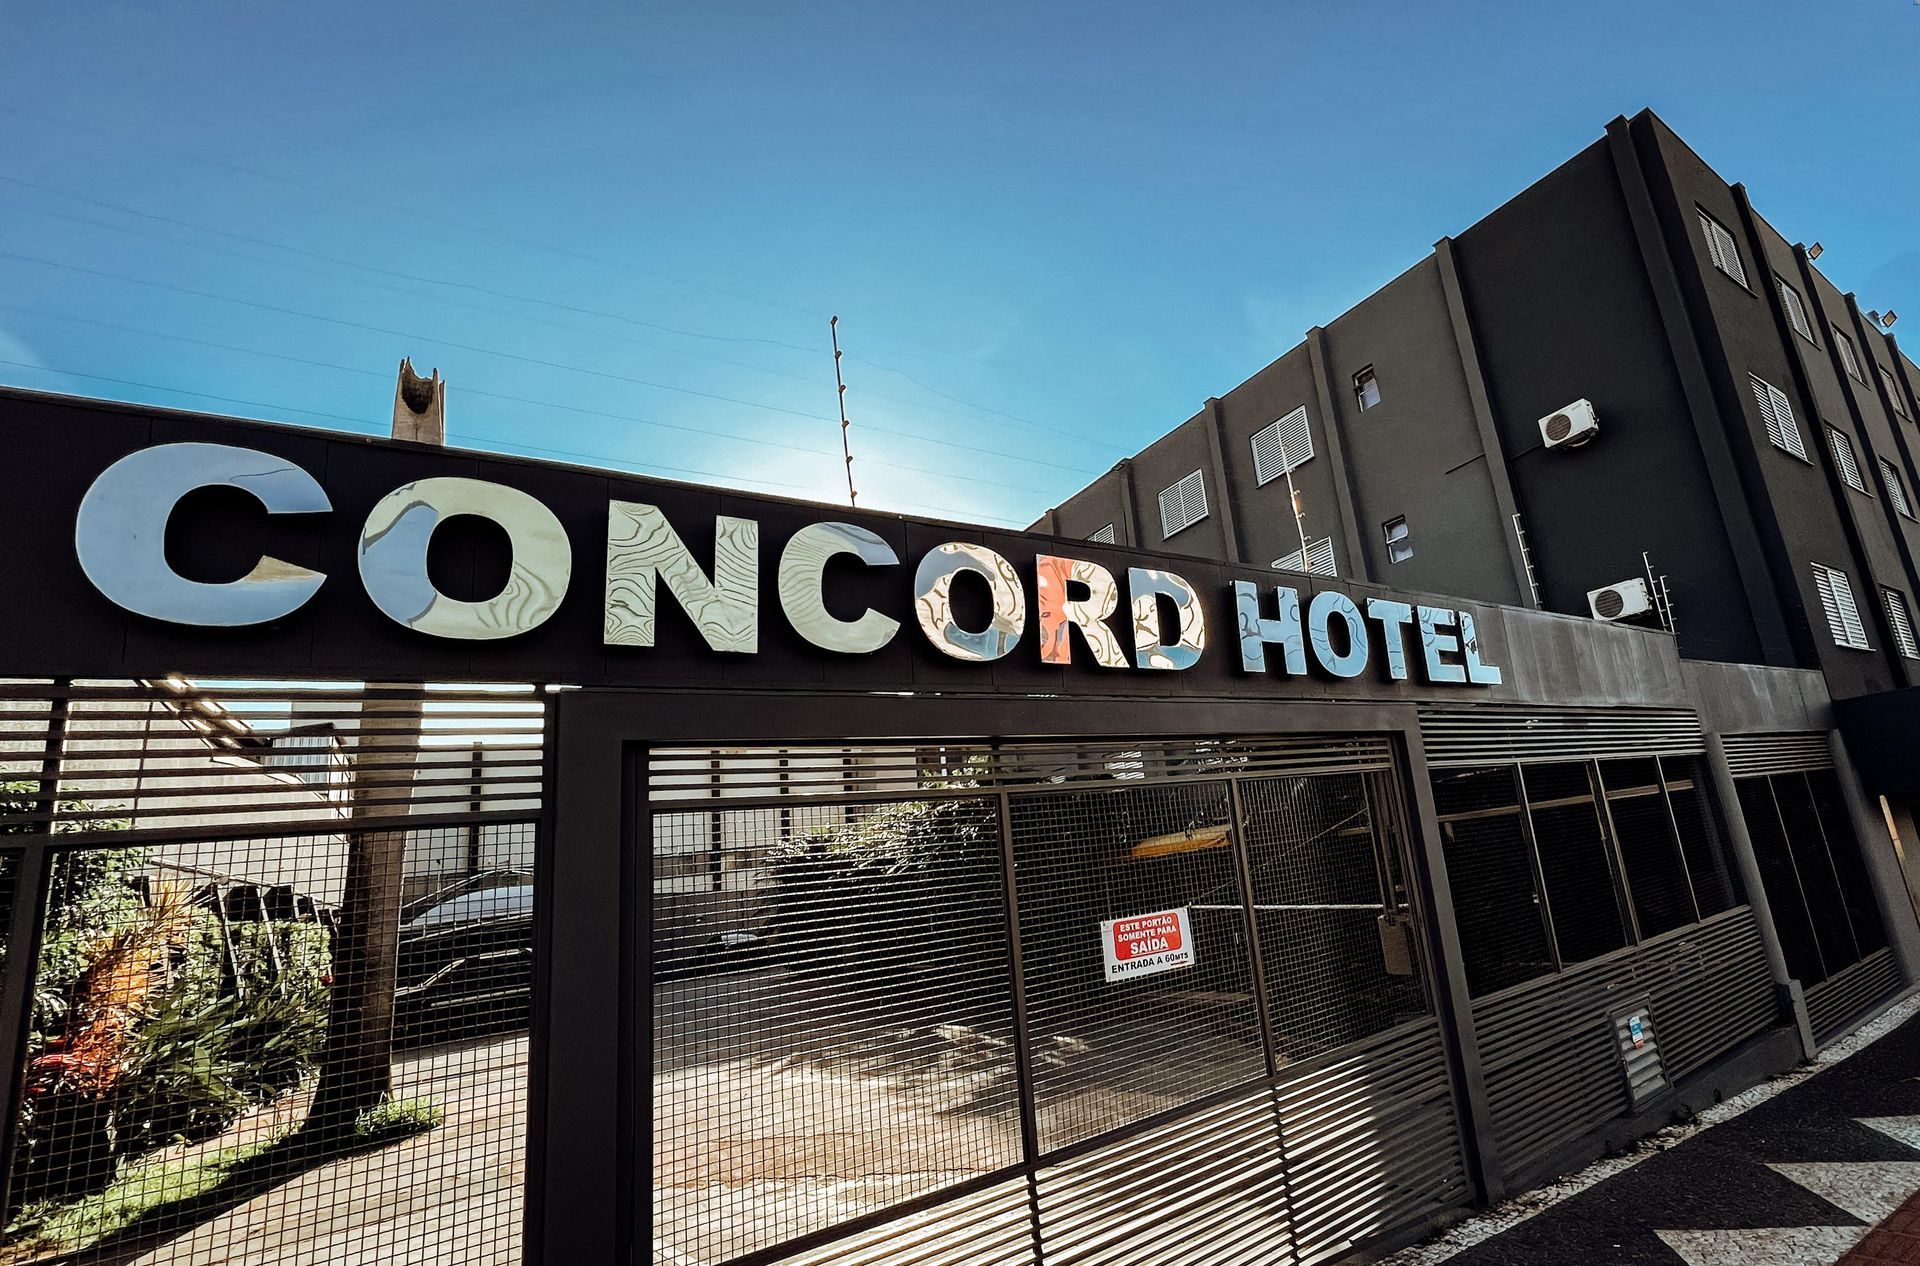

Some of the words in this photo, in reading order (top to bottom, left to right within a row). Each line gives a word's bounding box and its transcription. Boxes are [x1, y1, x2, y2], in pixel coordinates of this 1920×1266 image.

[76, 442, 1206, 671] CONCORD
[1234, 580, 1502, 685] HOTEL
[1120, 921, 1140, 932] ESTE
[1142, 916, 1172, 928] PORTÃO
[1118, 929, 1156, 942] SOMENTE
[1157, 925, 1177, 935] PARA
[1130, 937, 1168, 955] SAÍDA
[1111, 957, 1155, 974] ENTRADA
[1156, 956, 1163, 965] A
